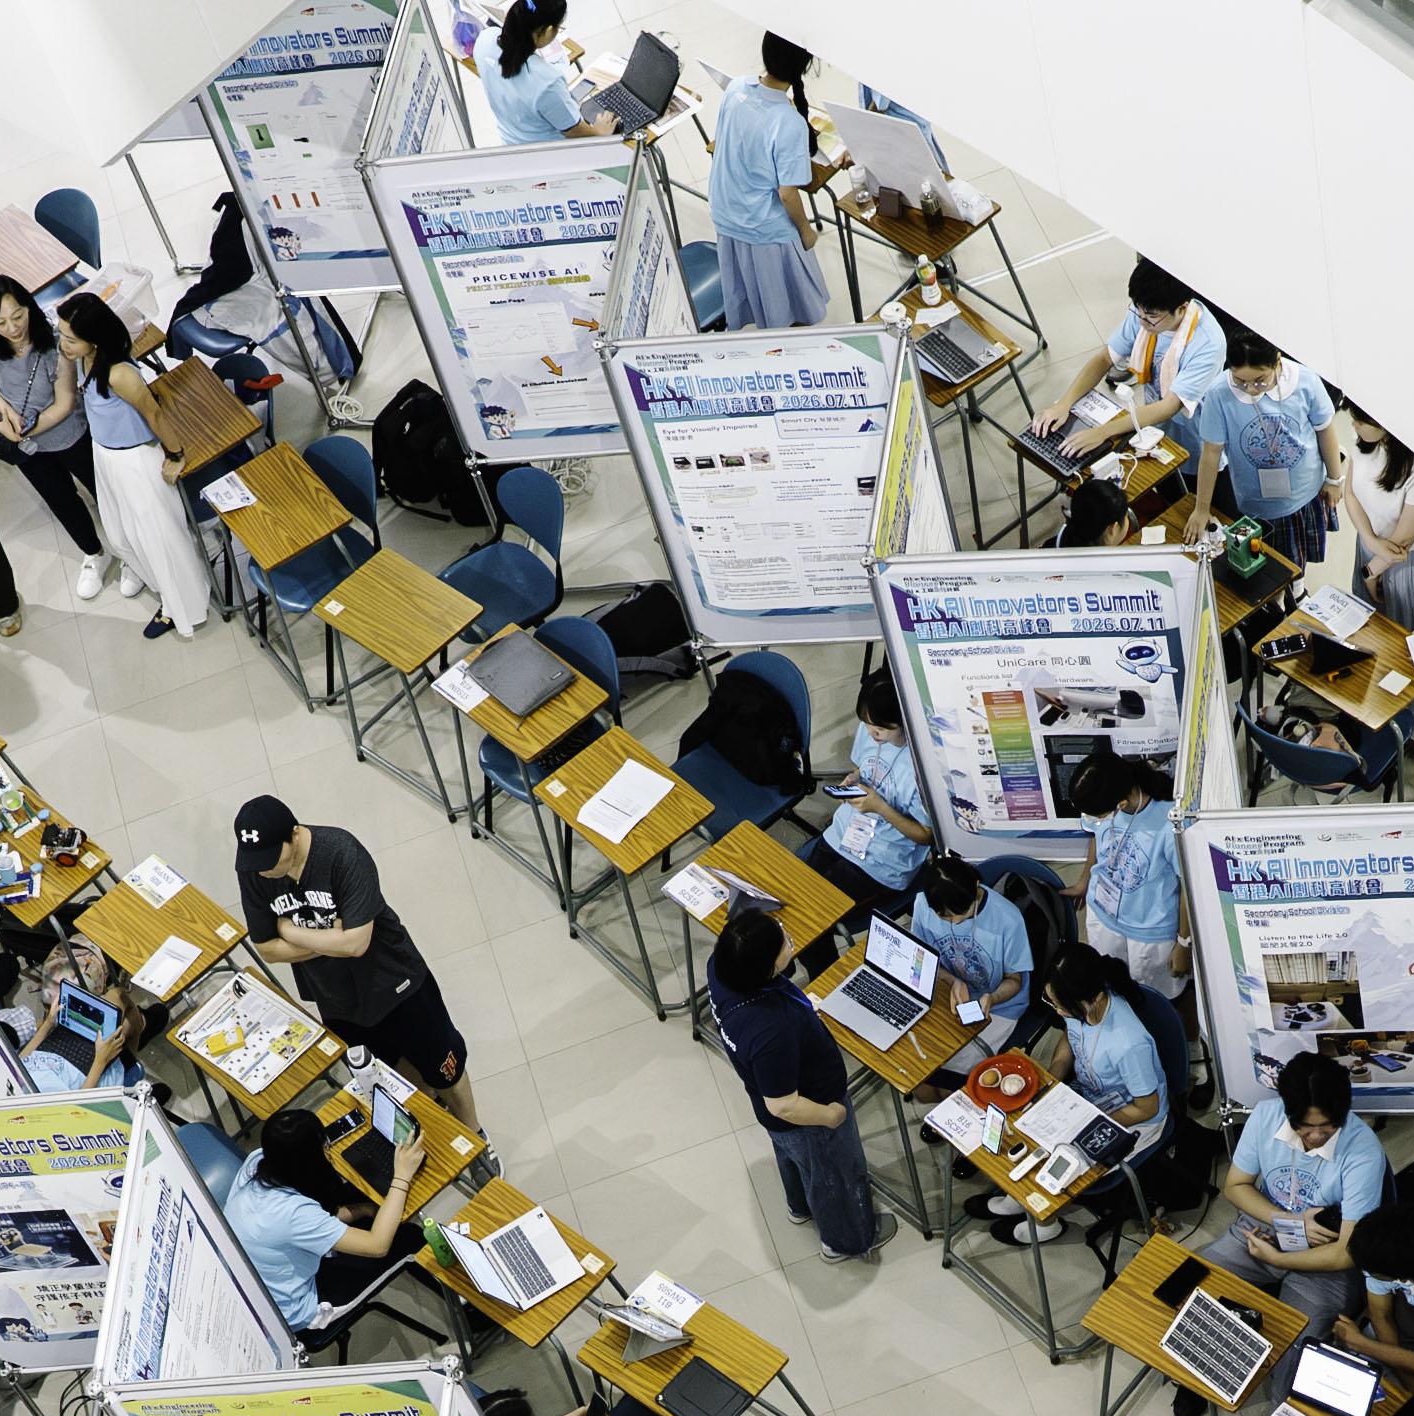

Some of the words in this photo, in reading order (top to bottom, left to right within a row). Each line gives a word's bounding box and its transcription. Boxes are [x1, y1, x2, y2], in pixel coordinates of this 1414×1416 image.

[417, 212, 447, 235] HK
[451, 213, 470, 232] AI
[472, 202, 566, 228] Innovators
[569, 195, 624, 219] Summi
[473, 268, 556, 282] PRICEWISE
[650, 352, 699, 360] Engineering
[639, 378, 671, 400] HK
[675, 378, 693, 398] AI
[696, 370, 794, 394] Innovators
[798, 367, 868, 390] Summit
[782, 394, 867, 408] 2026.07.11
[909, 598, 943, 620] HK
[947, 598, 967, 618] AI
[970, 595, 1081, 617] Innovators
[1086, 591, 1162, 613] Summit
[915, 618, 1052, 639] 香港AI創科高峰會
[1071, 616, 1165, 633] 2026.07.11
[927, 648, 968, 656] Secondary
[997, 658, 1046, 668] UniCare
[1051, 656, 1091, 666] 同心圓
[1244, 834, 1302, 842] Engineering
[1264, 840, 1306, 848] Program
[1226, 859, 1263, 882] HK
[1267, 860, 1291, 880] AI
[690, 886, 703, 898] B17
[1232, 879, 1382, 900] 香港AI創科高峰會
[678, 887, 699, 907] SCS10
[1244, 910, 1287, 919] Secondary
[1289, 908, 1316, 916] School
[957, 1116, 971, 1130] B16
[58, 1128, 129, 1152] Summit
[137, 1243, 162, 1347] Innovators
[152, 1175, 172, 1246] Summit
[657, 1284, 687, 1304] ENVS05
[657, 1295, 673, 1308] B11
